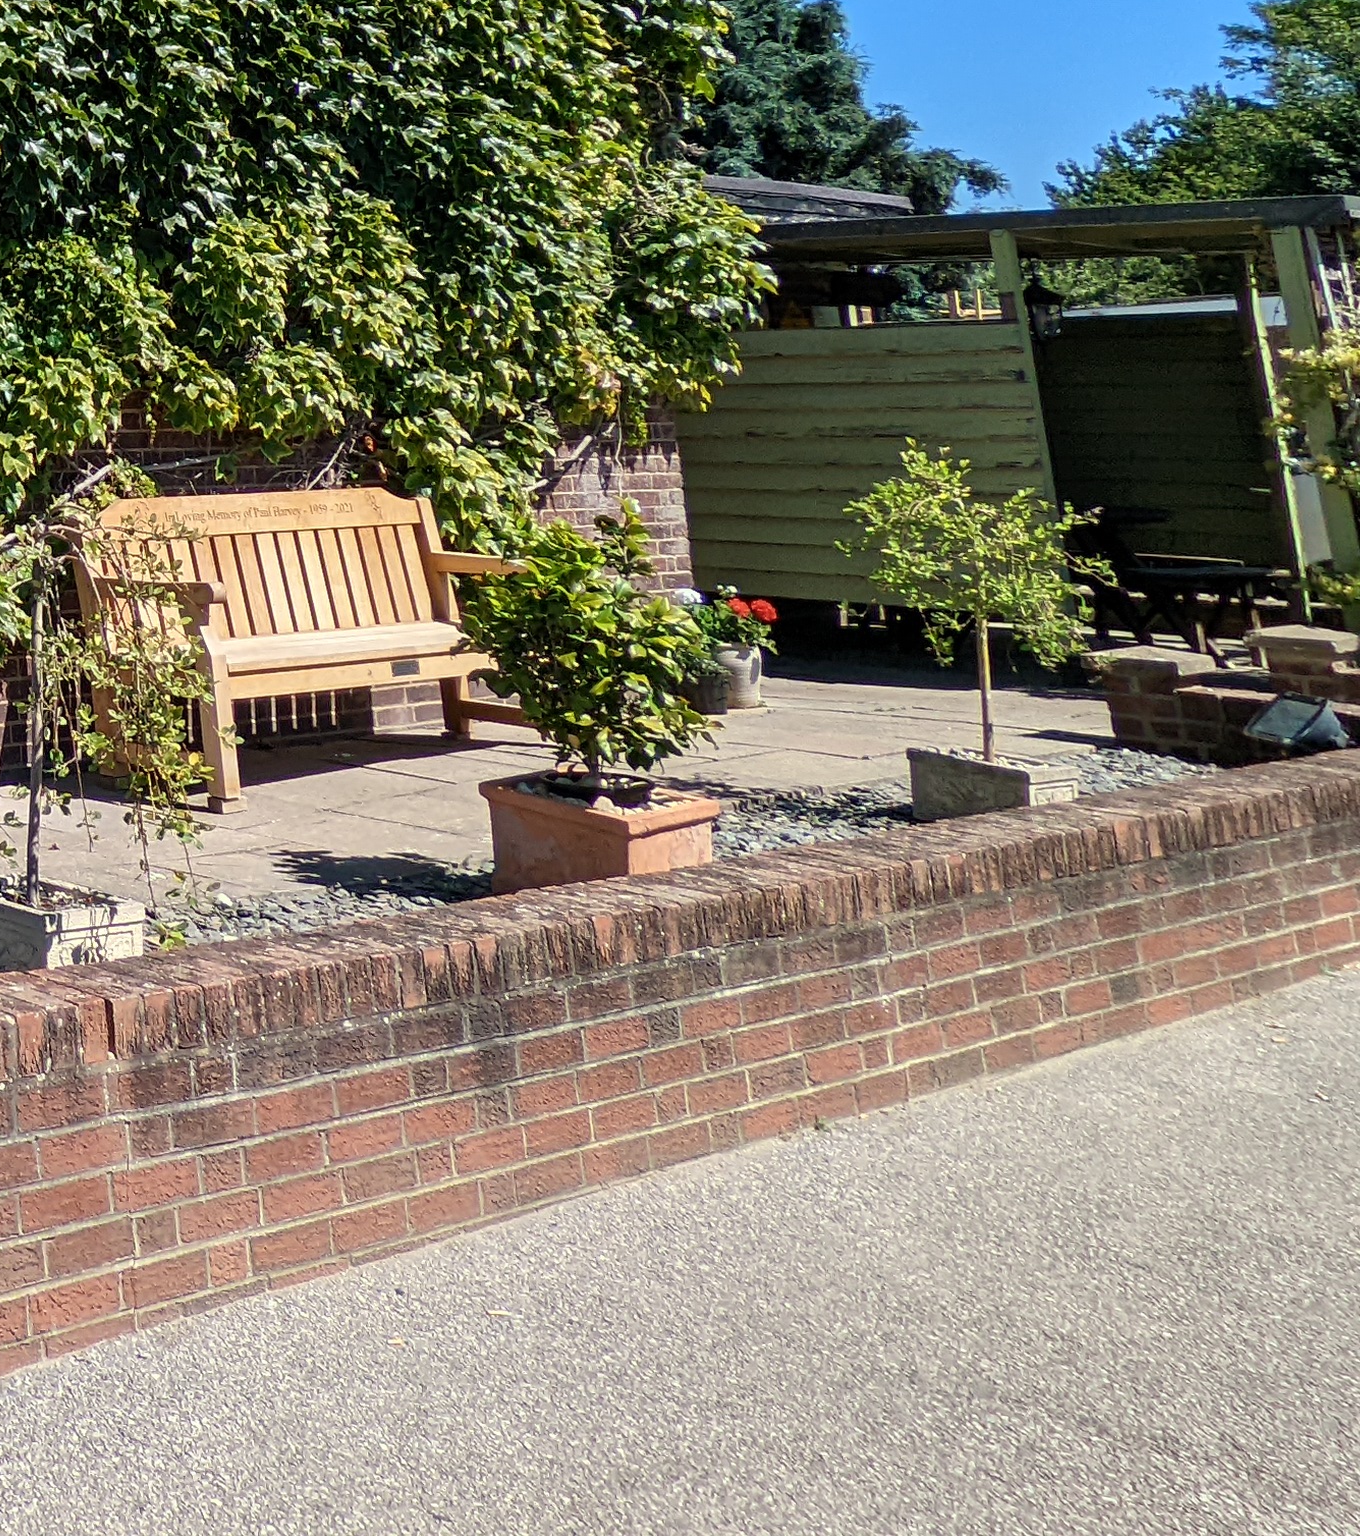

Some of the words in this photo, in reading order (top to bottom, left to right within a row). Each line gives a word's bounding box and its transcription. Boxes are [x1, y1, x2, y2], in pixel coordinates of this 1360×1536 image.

[175, 509, 206, 524] Loving
[206, 509, 241, 522] Memory
[243, 506, 253, 518] of
